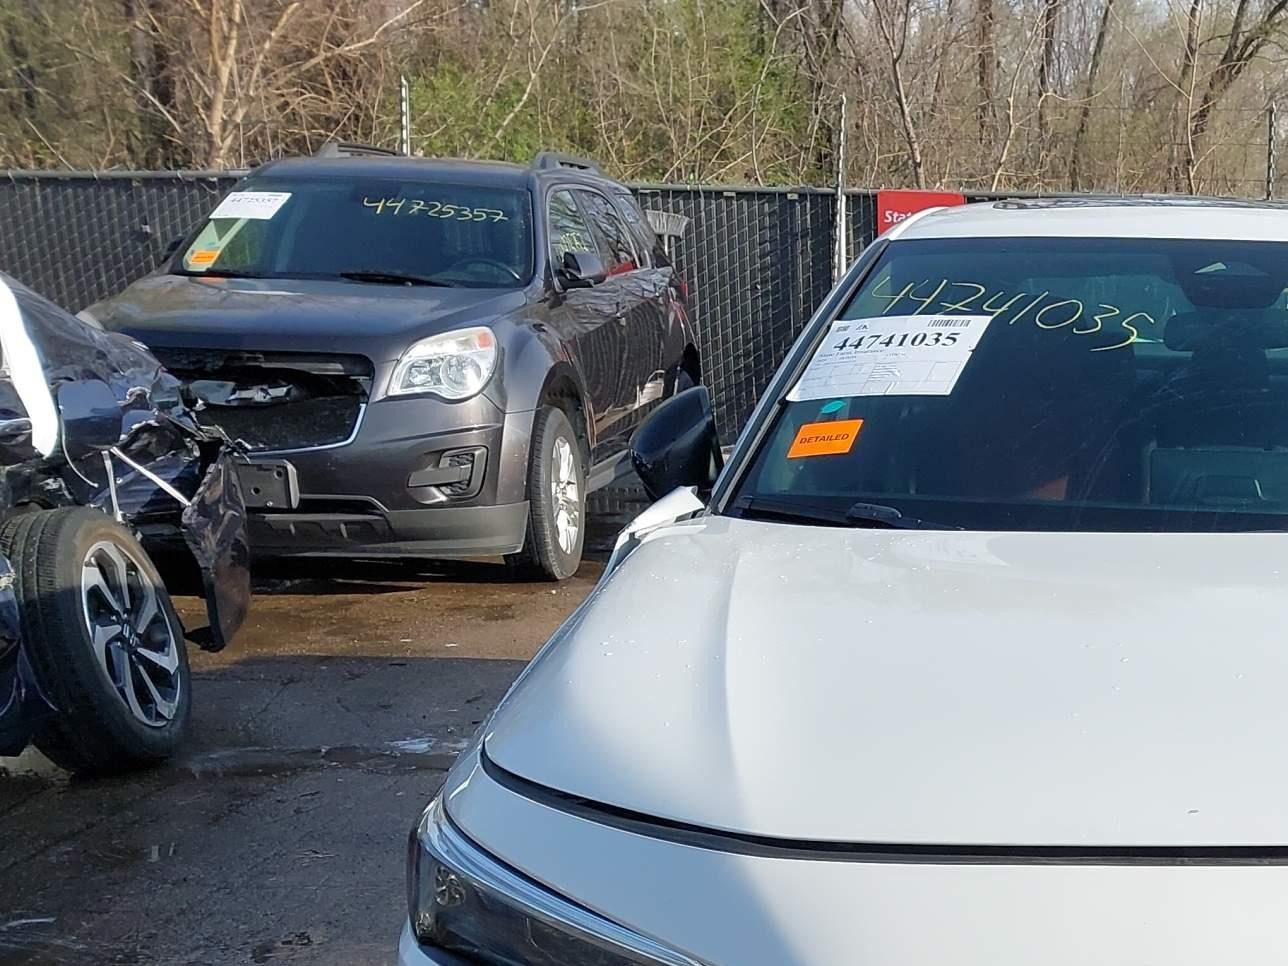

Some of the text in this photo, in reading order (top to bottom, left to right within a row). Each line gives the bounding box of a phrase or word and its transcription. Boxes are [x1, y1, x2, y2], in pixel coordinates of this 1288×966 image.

[363, 197, 509, 223] 44725357
[883, 210, 912, 223] Sta
[871, 276, 1155, 352] 44741035
[834, 332, 961, 351] 44741035
[799, 433, 850, 444] DETAILED
